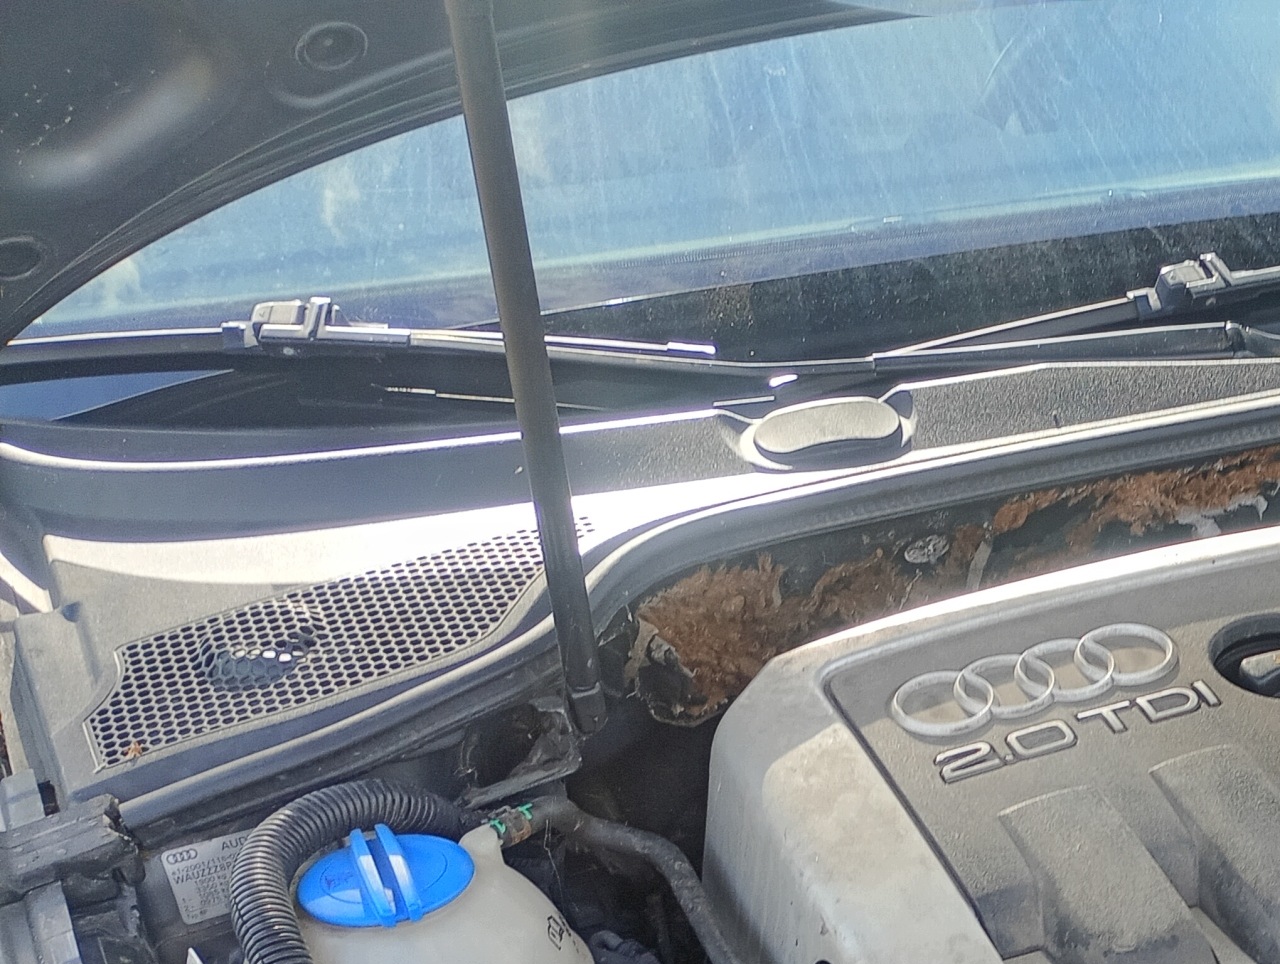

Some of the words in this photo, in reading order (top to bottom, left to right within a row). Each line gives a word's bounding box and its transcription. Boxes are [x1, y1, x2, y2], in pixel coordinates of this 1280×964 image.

[933, 719, 1078, 784] 2.0
[1075, 679, 1222, 734] TDI
[221, 836, 247, 851] AUD
[173, 861, 233, 885] WAUZZZ8P
